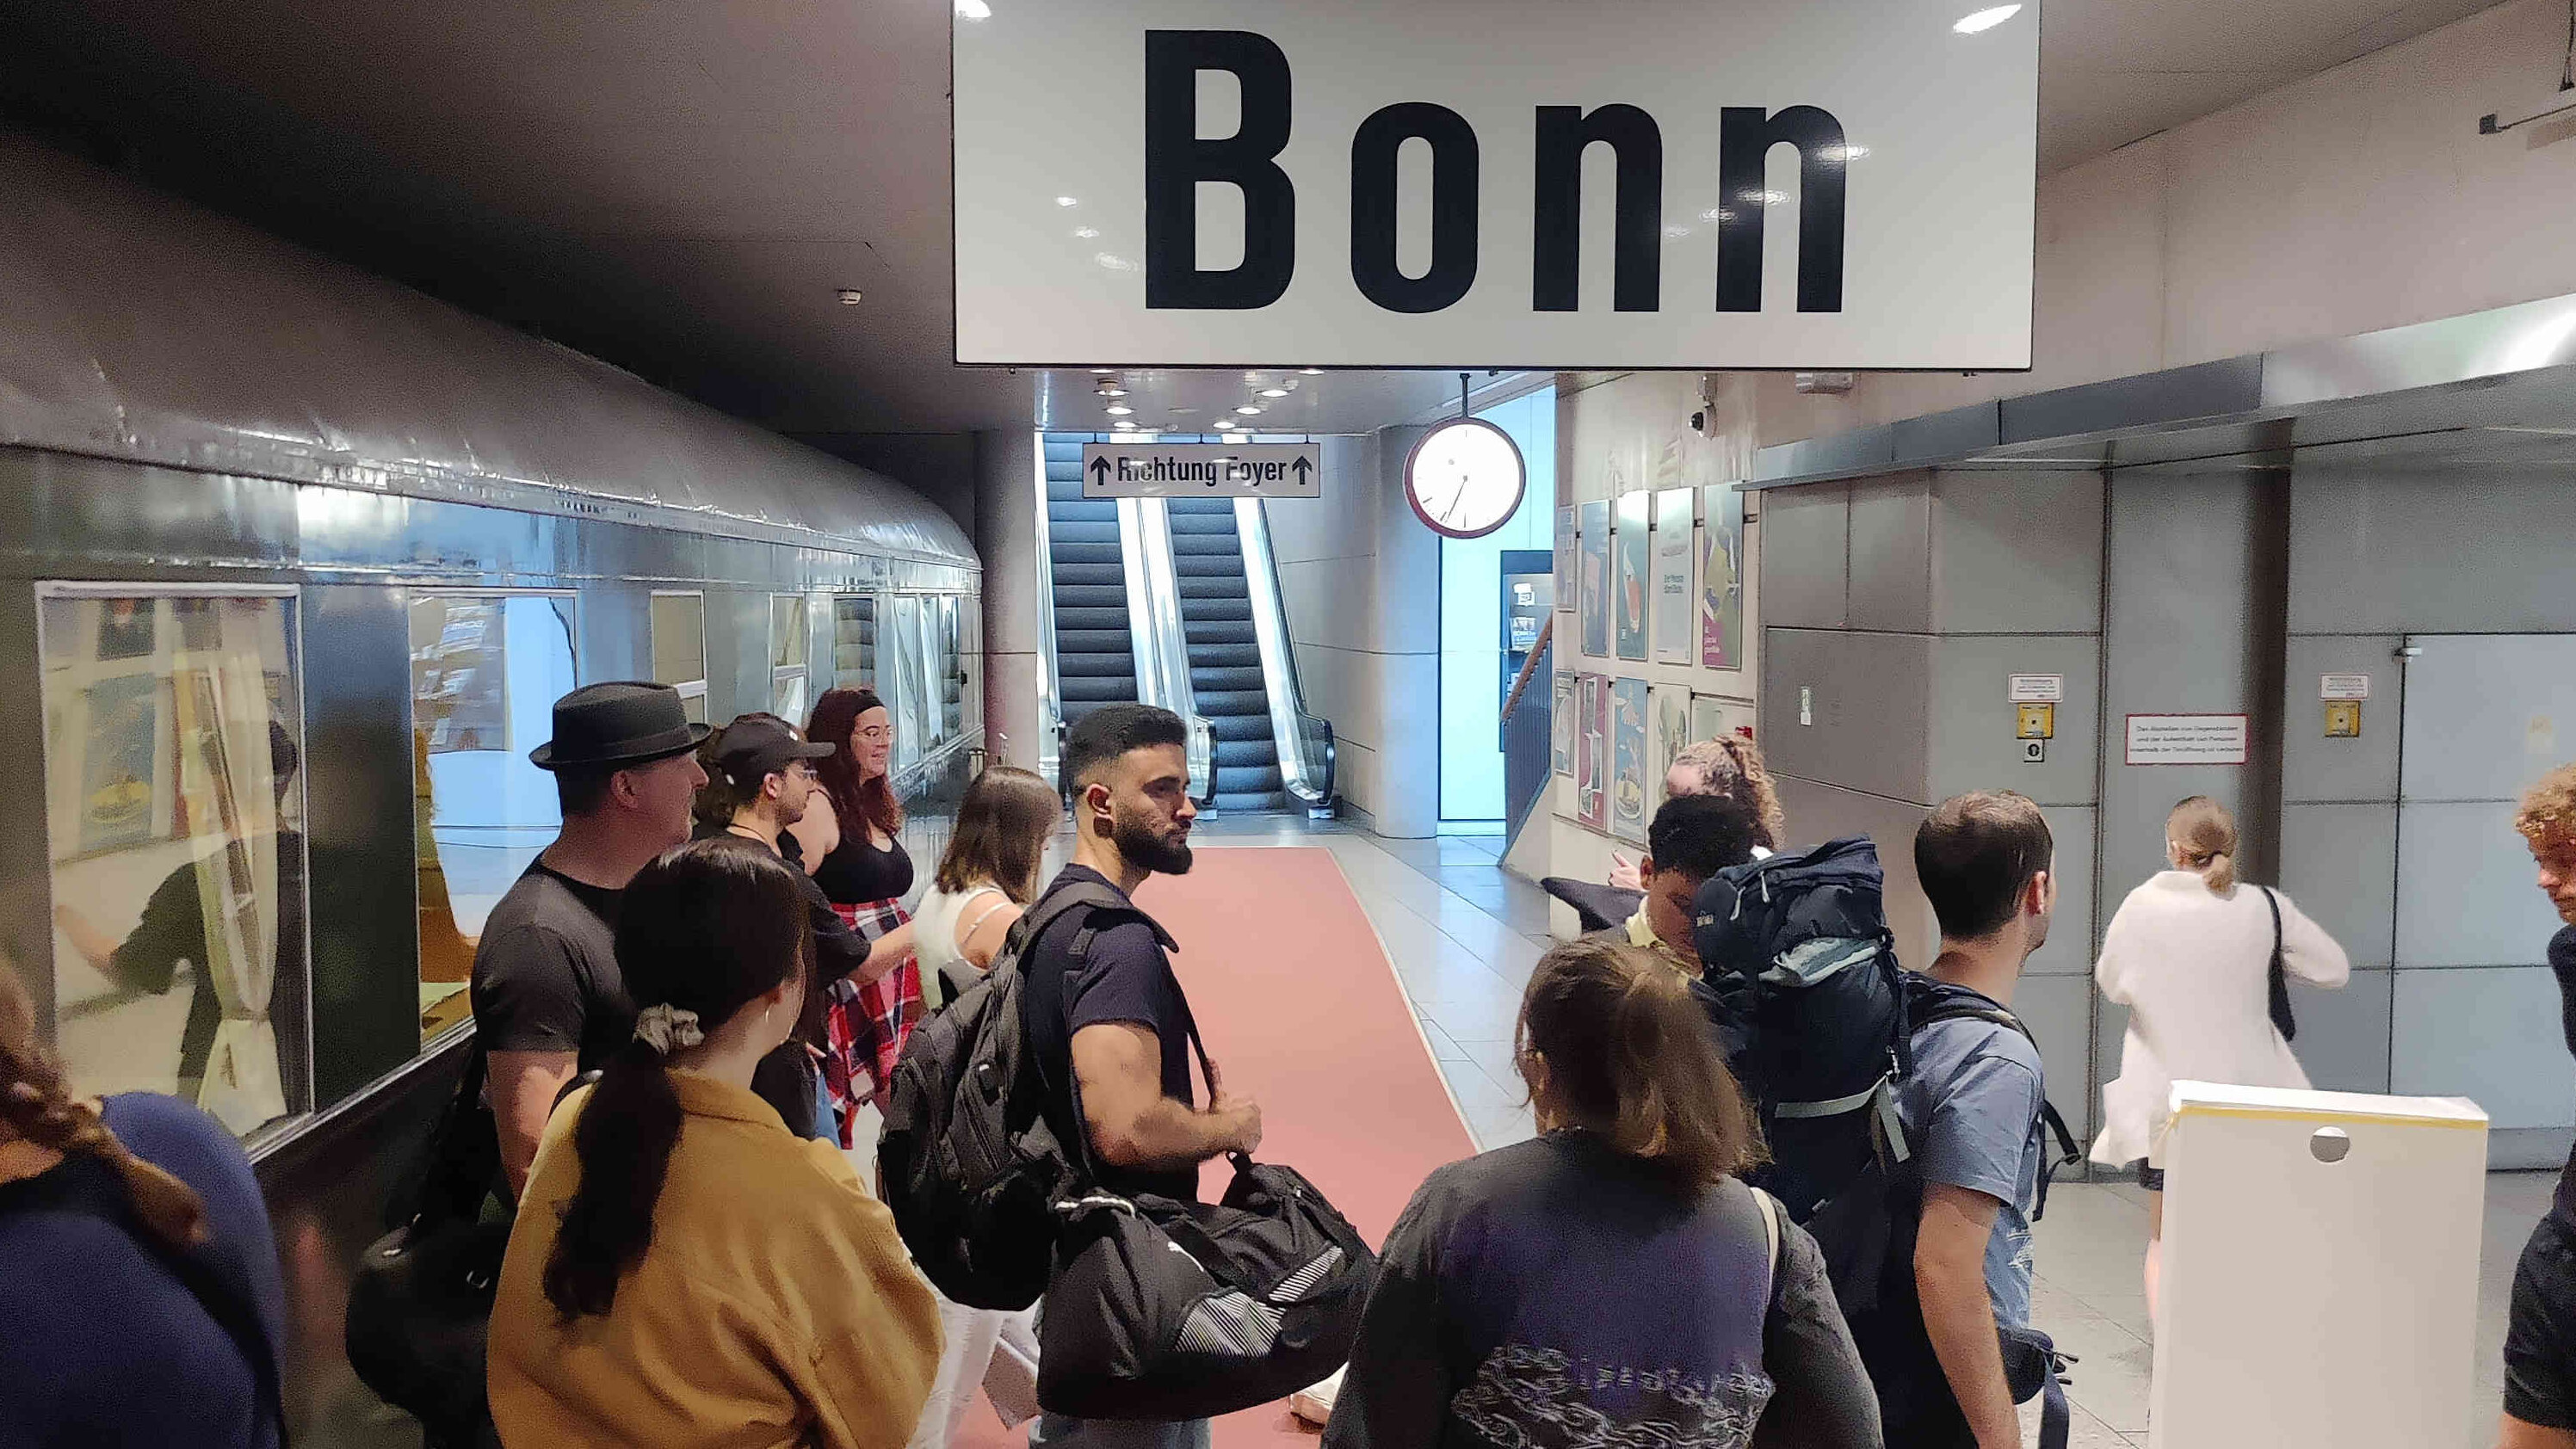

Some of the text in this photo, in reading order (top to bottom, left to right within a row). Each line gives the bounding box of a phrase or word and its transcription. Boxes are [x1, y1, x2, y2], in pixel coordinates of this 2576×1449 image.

[1146, 29, 1845, 313] Bonn
[1117, 456, 1287, 487] Richtung Foyer
